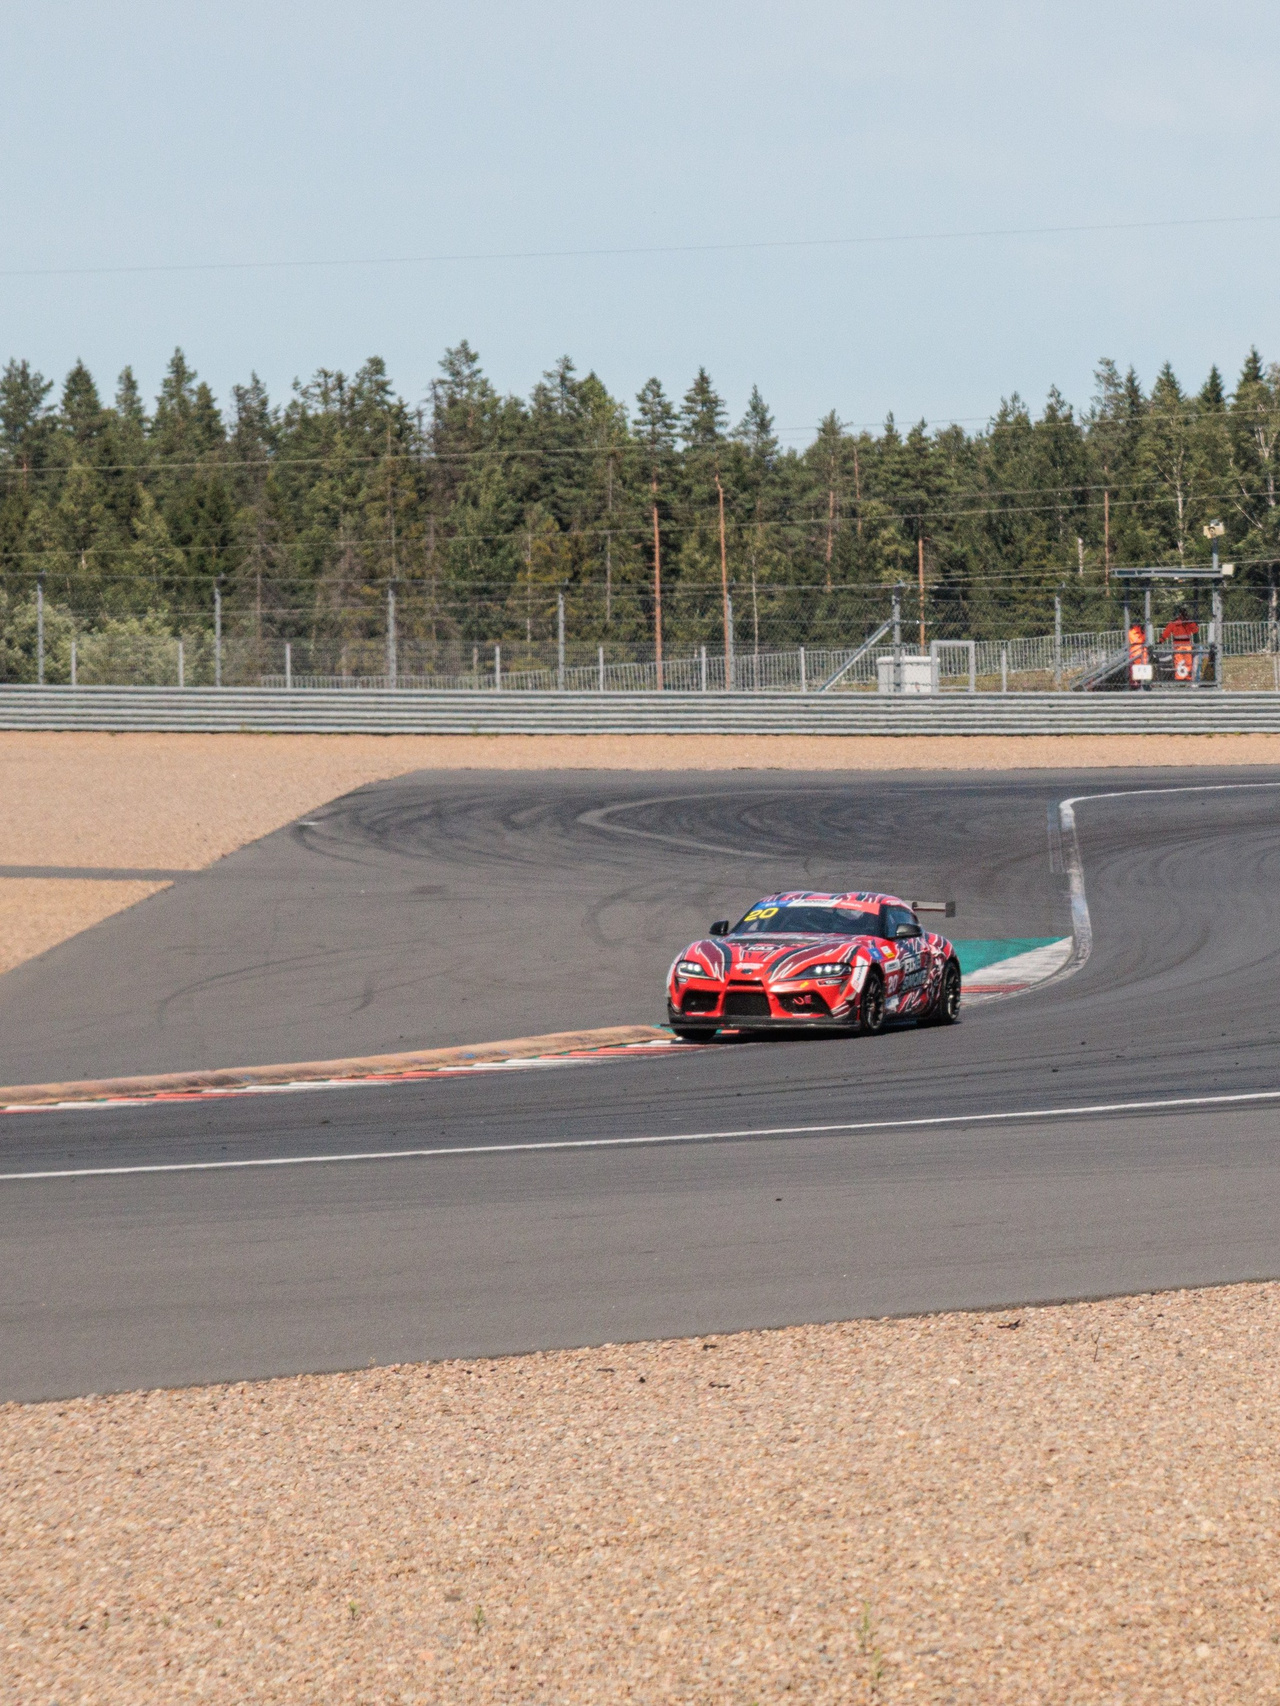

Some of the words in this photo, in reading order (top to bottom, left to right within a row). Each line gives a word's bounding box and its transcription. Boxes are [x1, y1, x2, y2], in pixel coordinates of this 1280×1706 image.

[1176, 659, 1189, 678] 6
[743, 907, 779, 922] 20
[887, 974, 898, 994] 20
